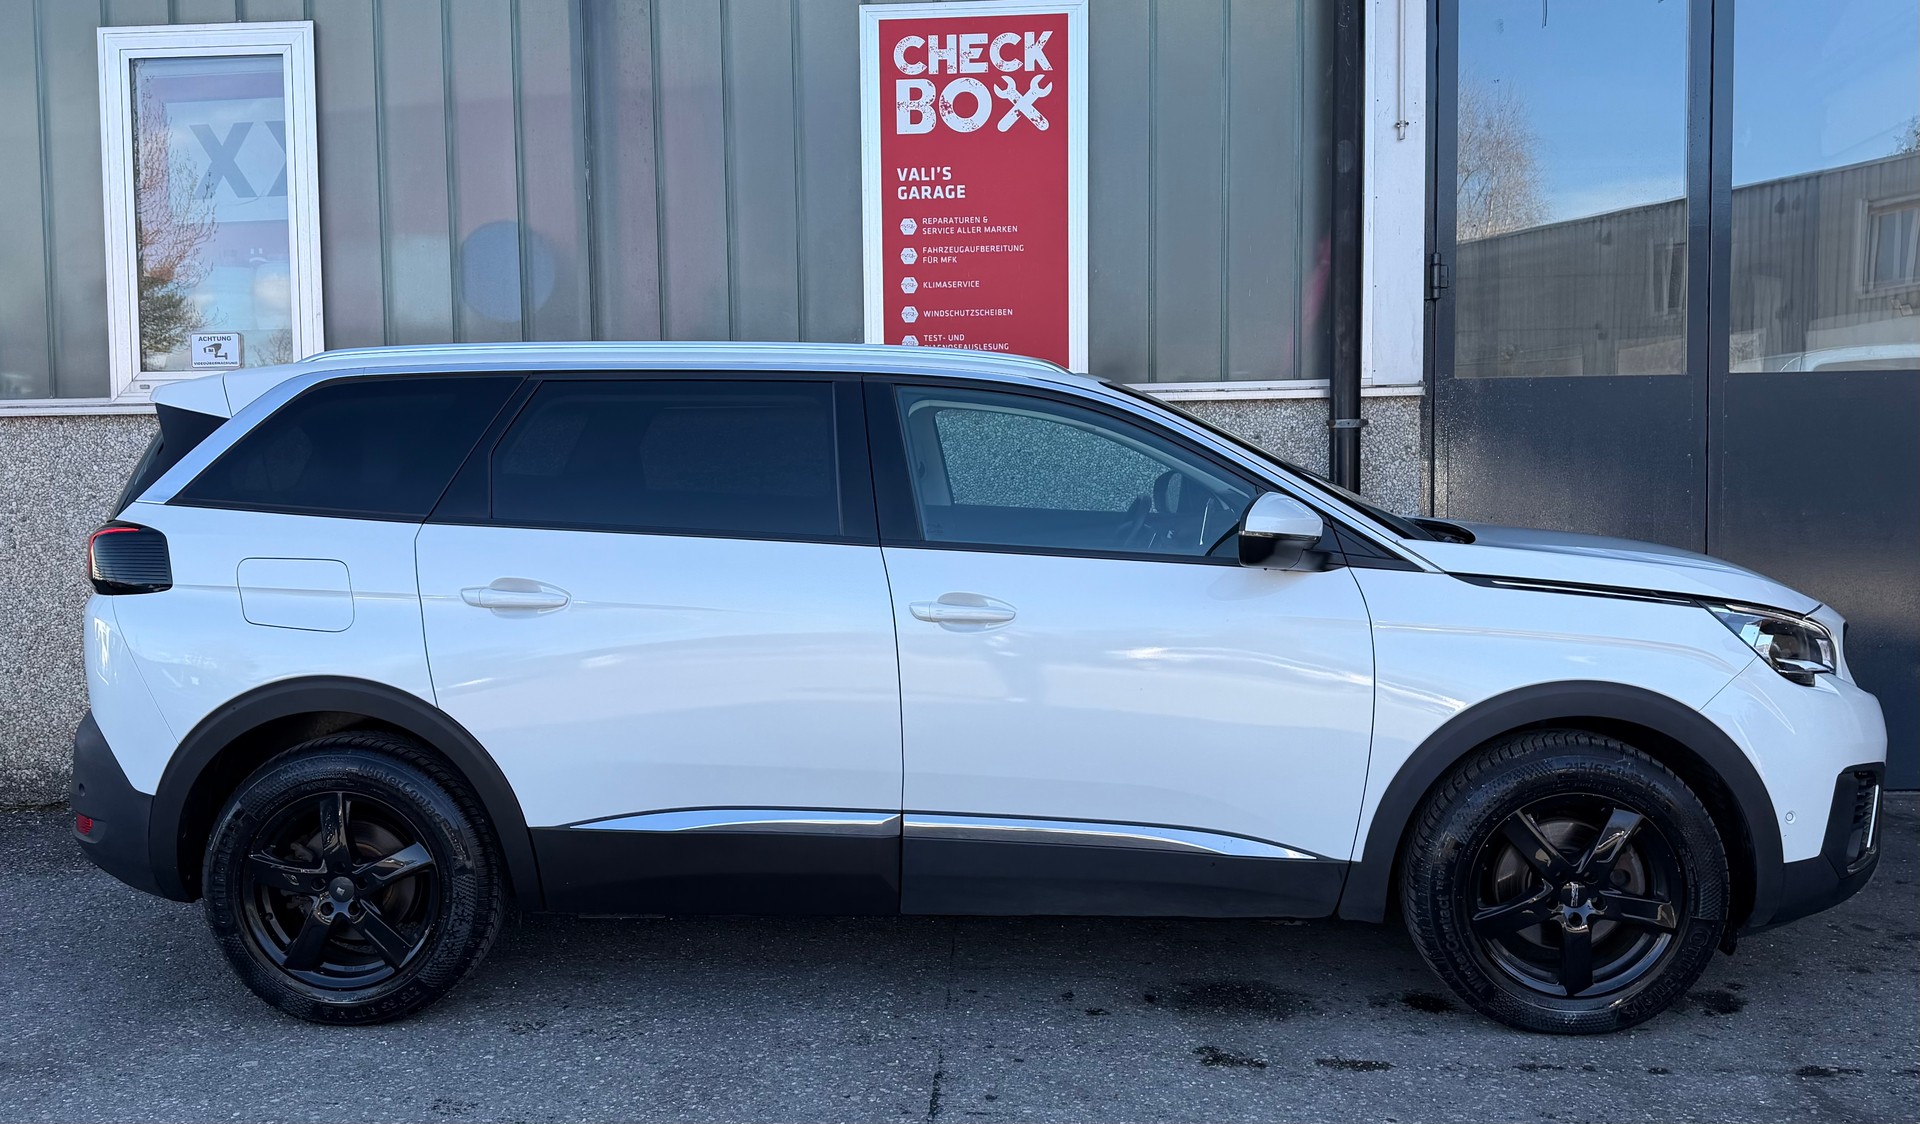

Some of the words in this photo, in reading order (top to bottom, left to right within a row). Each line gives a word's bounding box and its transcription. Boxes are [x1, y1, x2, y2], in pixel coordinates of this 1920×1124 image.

[893, 31, 1054, 76] CHECK
[895, 74, 1053, 135] BOX
[896, 166, 952, 182] VALI'S
[897, 184, 966, 200] GARAGE
[922, 216, 981, 225] REPARATUREN
[982, 216, 989, 224] &
[922, 226, 955, 235] SERVICE
[956, 226, 982, 234] ALLER
[983, 225, 1018, 234] MARKEN
[922, 244, 1025, 254] FAHRZEUGAUFBEREITUNG
[922, 255, 939, 264] FÜR
[922, 280, 980, 289] KLIMASERVICE
[923, 308, 1013, 317] WINDSCHUTZSCHEIBEN
[923, 334, 946, 342] TEST-
[947, 333, 965, 341] UND
